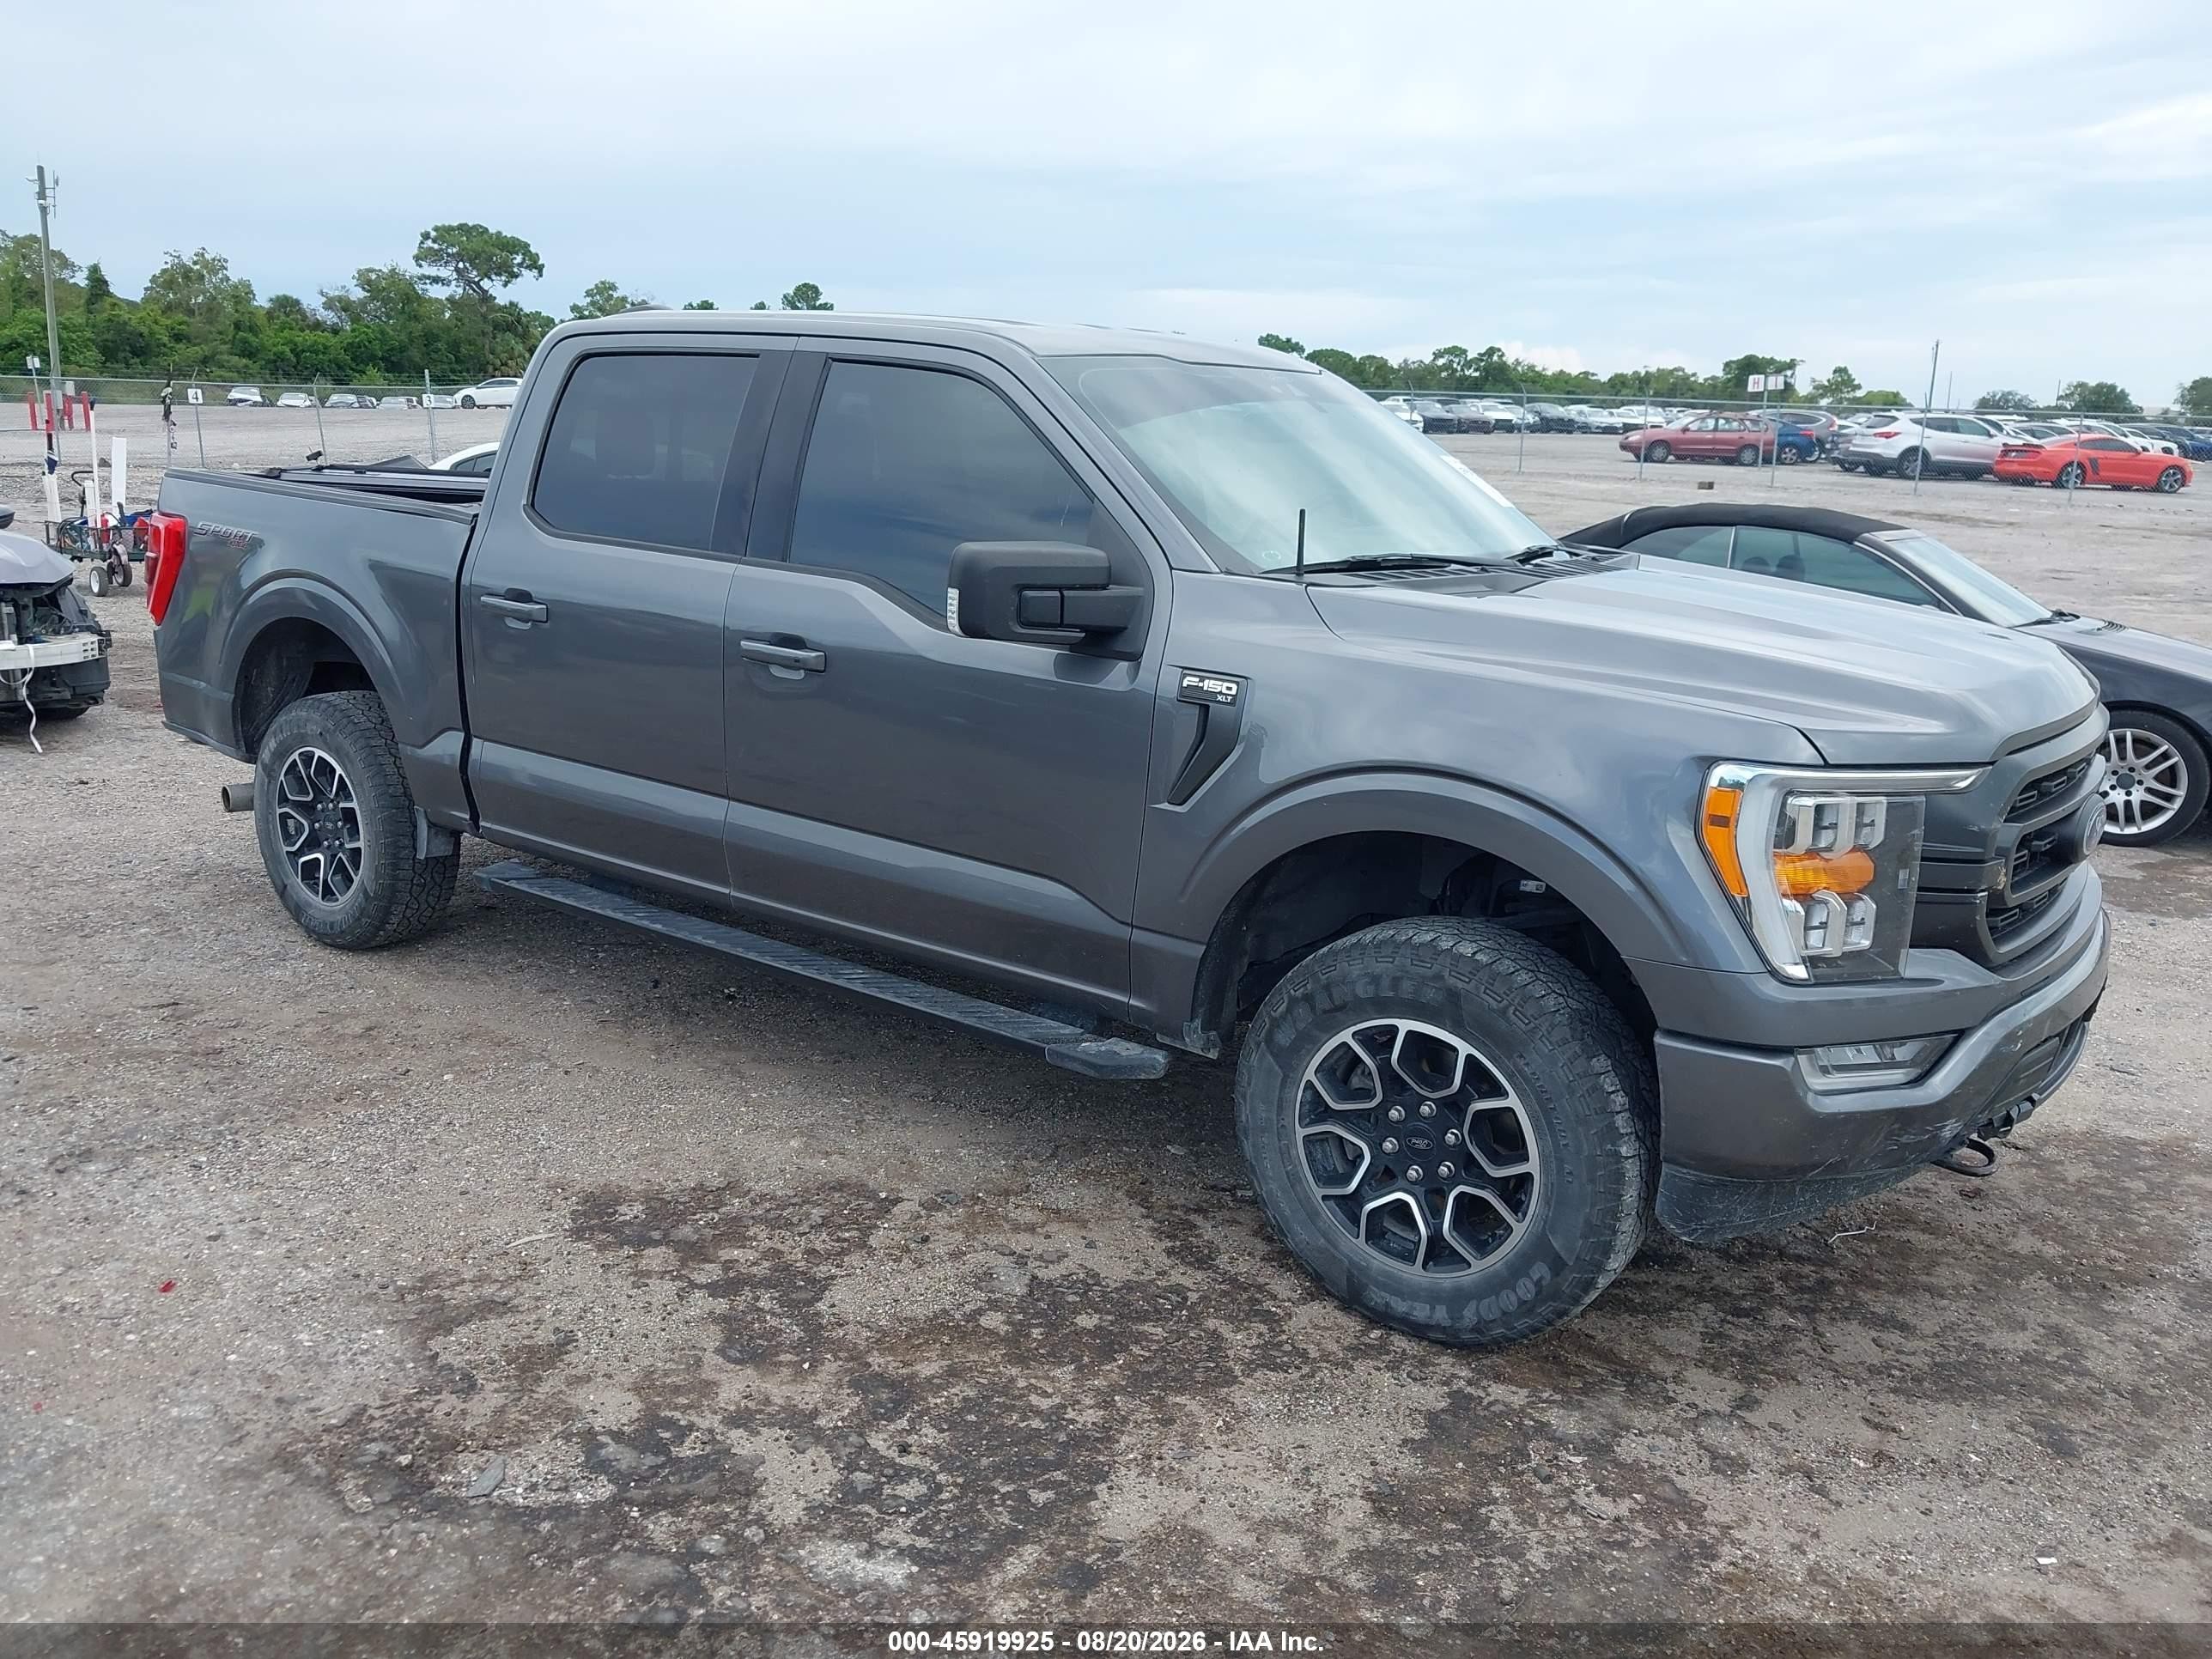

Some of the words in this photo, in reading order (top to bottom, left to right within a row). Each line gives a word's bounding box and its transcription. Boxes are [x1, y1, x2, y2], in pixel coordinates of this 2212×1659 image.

[191, 390, 199, 402] 4
[425, 395, 432, 406] 3
[193, 521, 260, 542] SPORT
[1182, 676, 1238, 696] F-150
[1216, 694, 1233, 703] XLT
